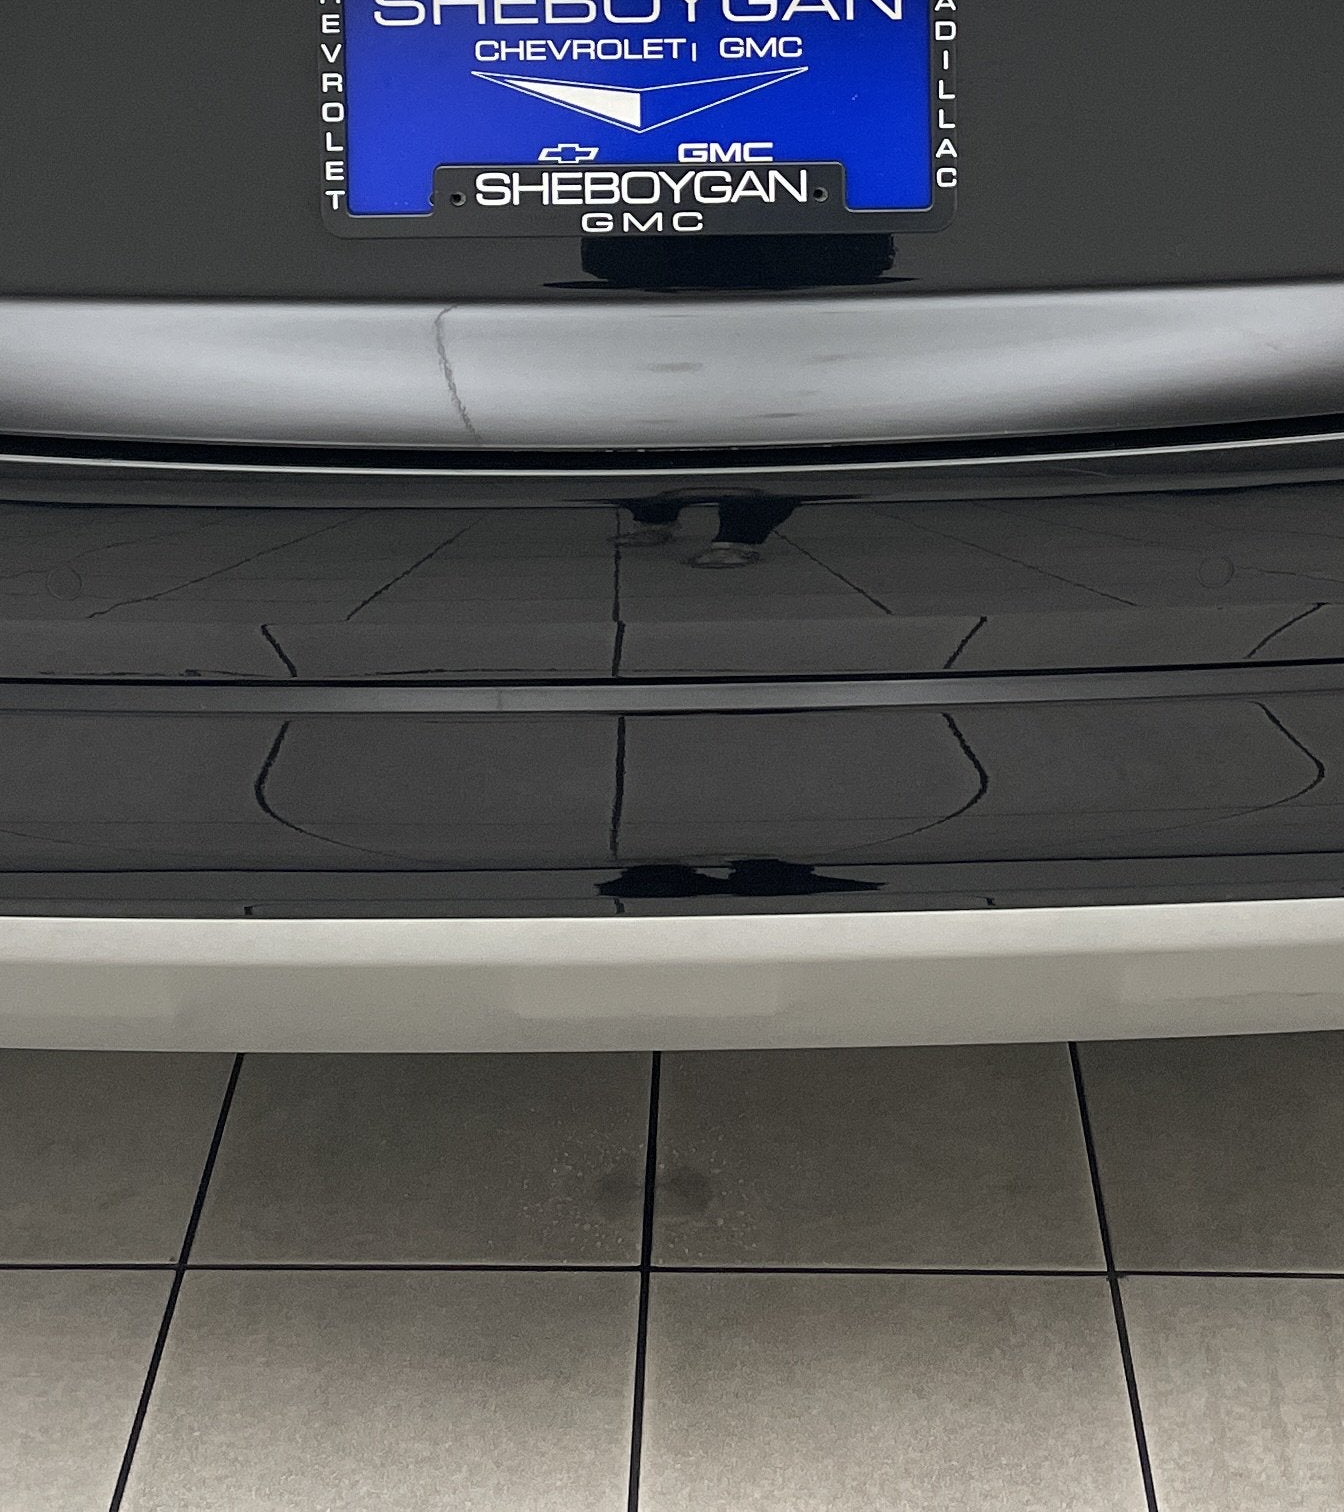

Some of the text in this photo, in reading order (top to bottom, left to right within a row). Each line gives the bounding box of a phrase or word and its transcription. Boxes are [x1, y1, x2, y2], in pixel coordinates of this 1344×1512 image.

[475, 36, 803, 61] CHEVROLET GMC
[677, 142, 774, 163] GMC
[475, 169, 808, 206] SHEBOYGAN
[581, 211, 704, 233] GMC
